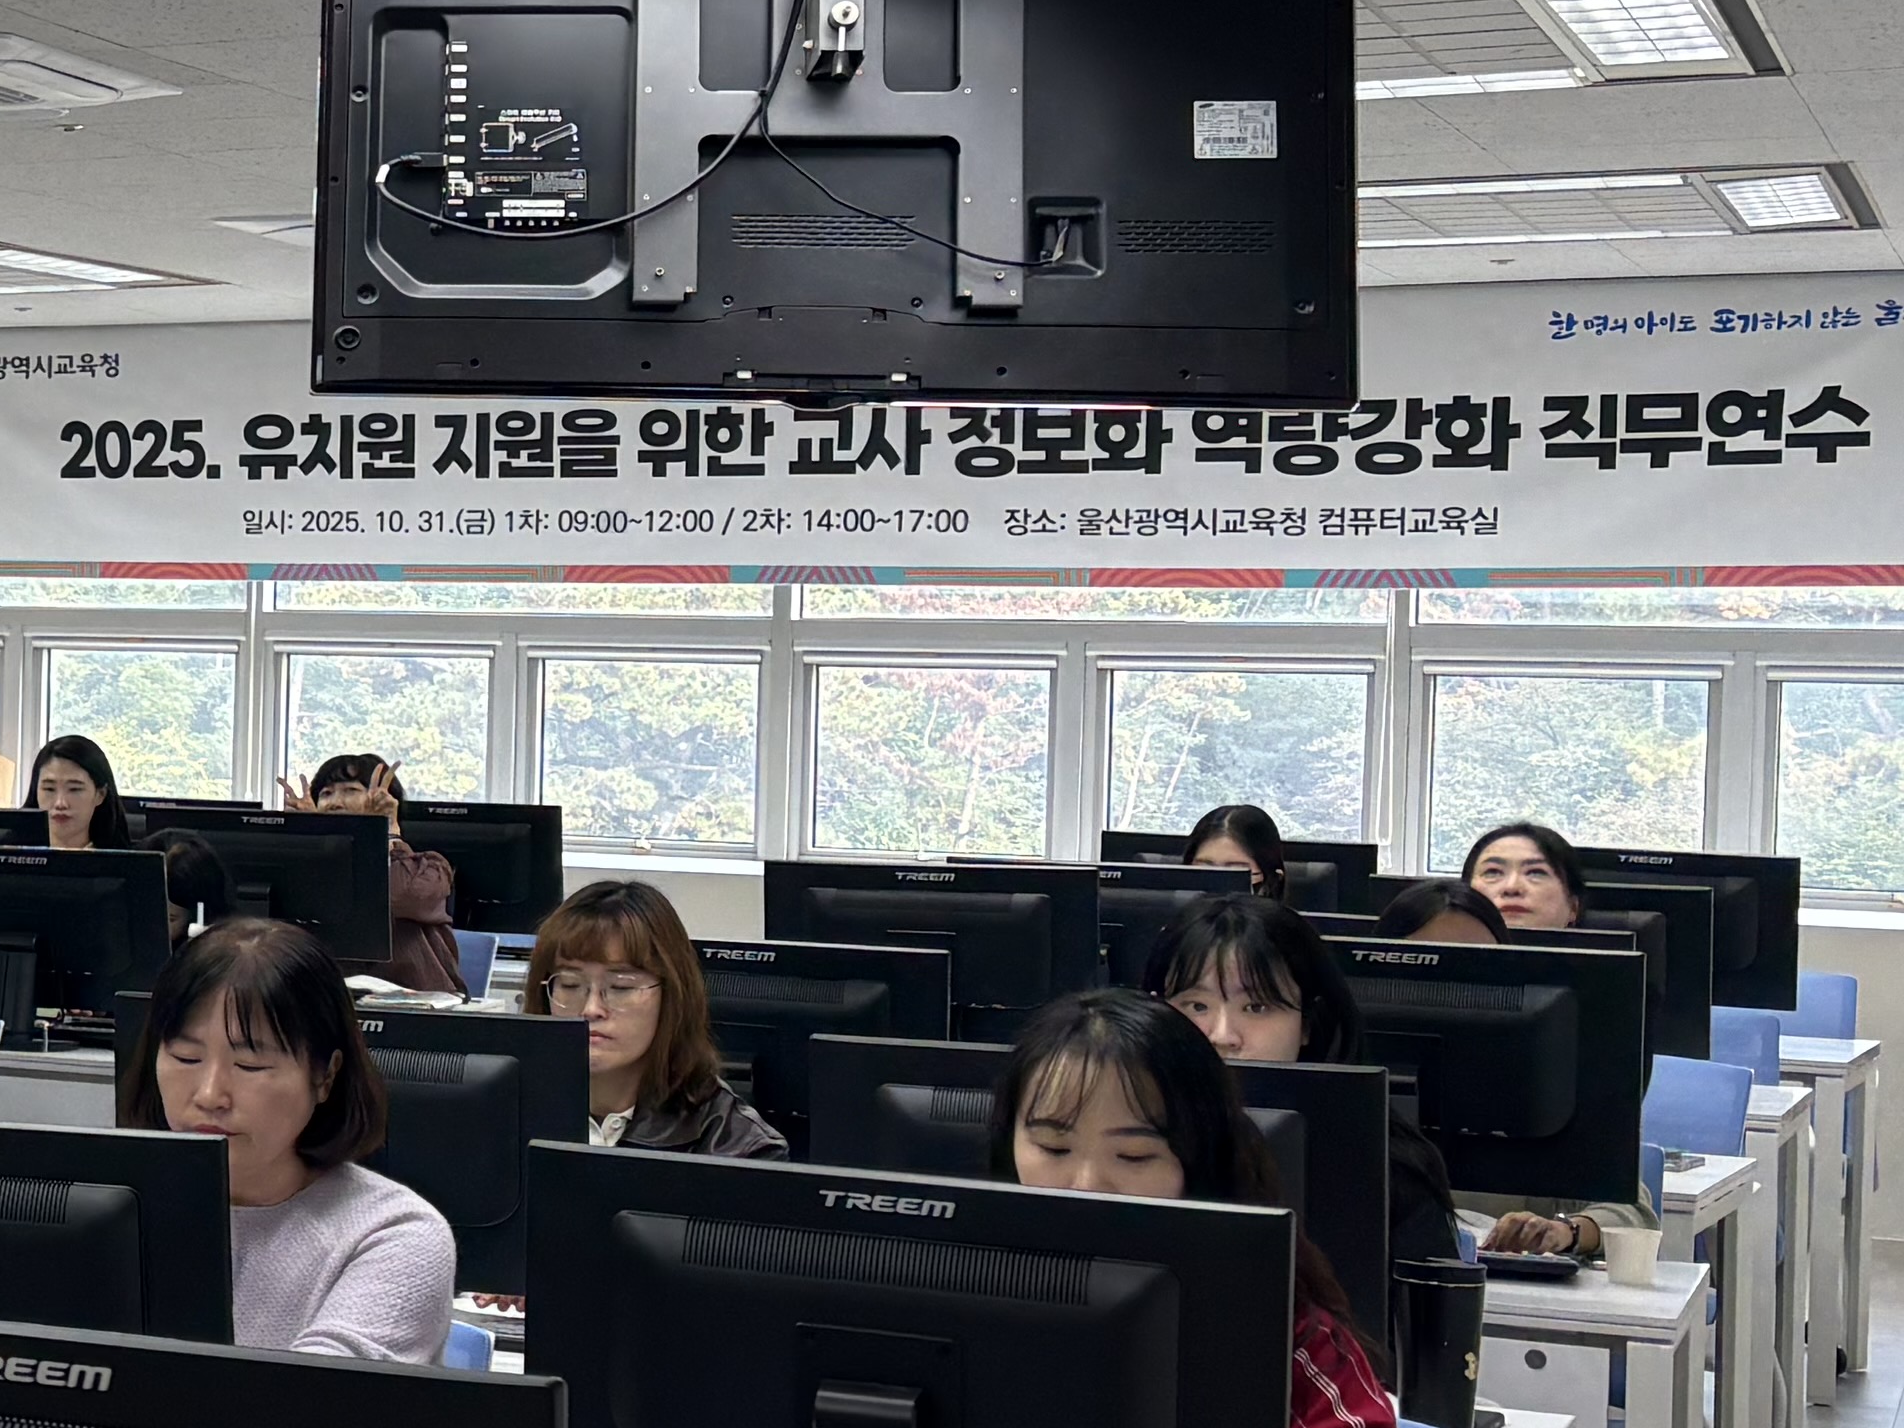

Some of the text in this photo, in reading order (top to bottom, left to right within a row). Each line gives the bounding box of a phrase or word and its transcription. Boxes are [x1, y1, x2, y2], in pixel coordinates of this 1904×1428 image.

[1549, 311, 1579, 340] 한
[1583, 315, 1628, 337] 명의
[1634, 310, 1697, 336] 아이도
[1709, 308, 1811, 334] 포기하지
[1819, 304, 1862, 330] 않는
[60, 385, 1871, 480] 2025. 유치원 지원을 위한 교사 정보화 역량강화 직무연수
[243, 506, 1499, 537] 일시: 2025. 10. 31.(금) 1차: 09:00~12:00 / 2차: 14:00~17:00 장소: 울산광역시교육청 컴퓨터교육실
[895, 872, 954, 882] TREEM
[703, 948, 775, 962] TREEM
[1352, 950, 1439, 965] TREEM
[818, 1189, 956, 1219] TREEM
